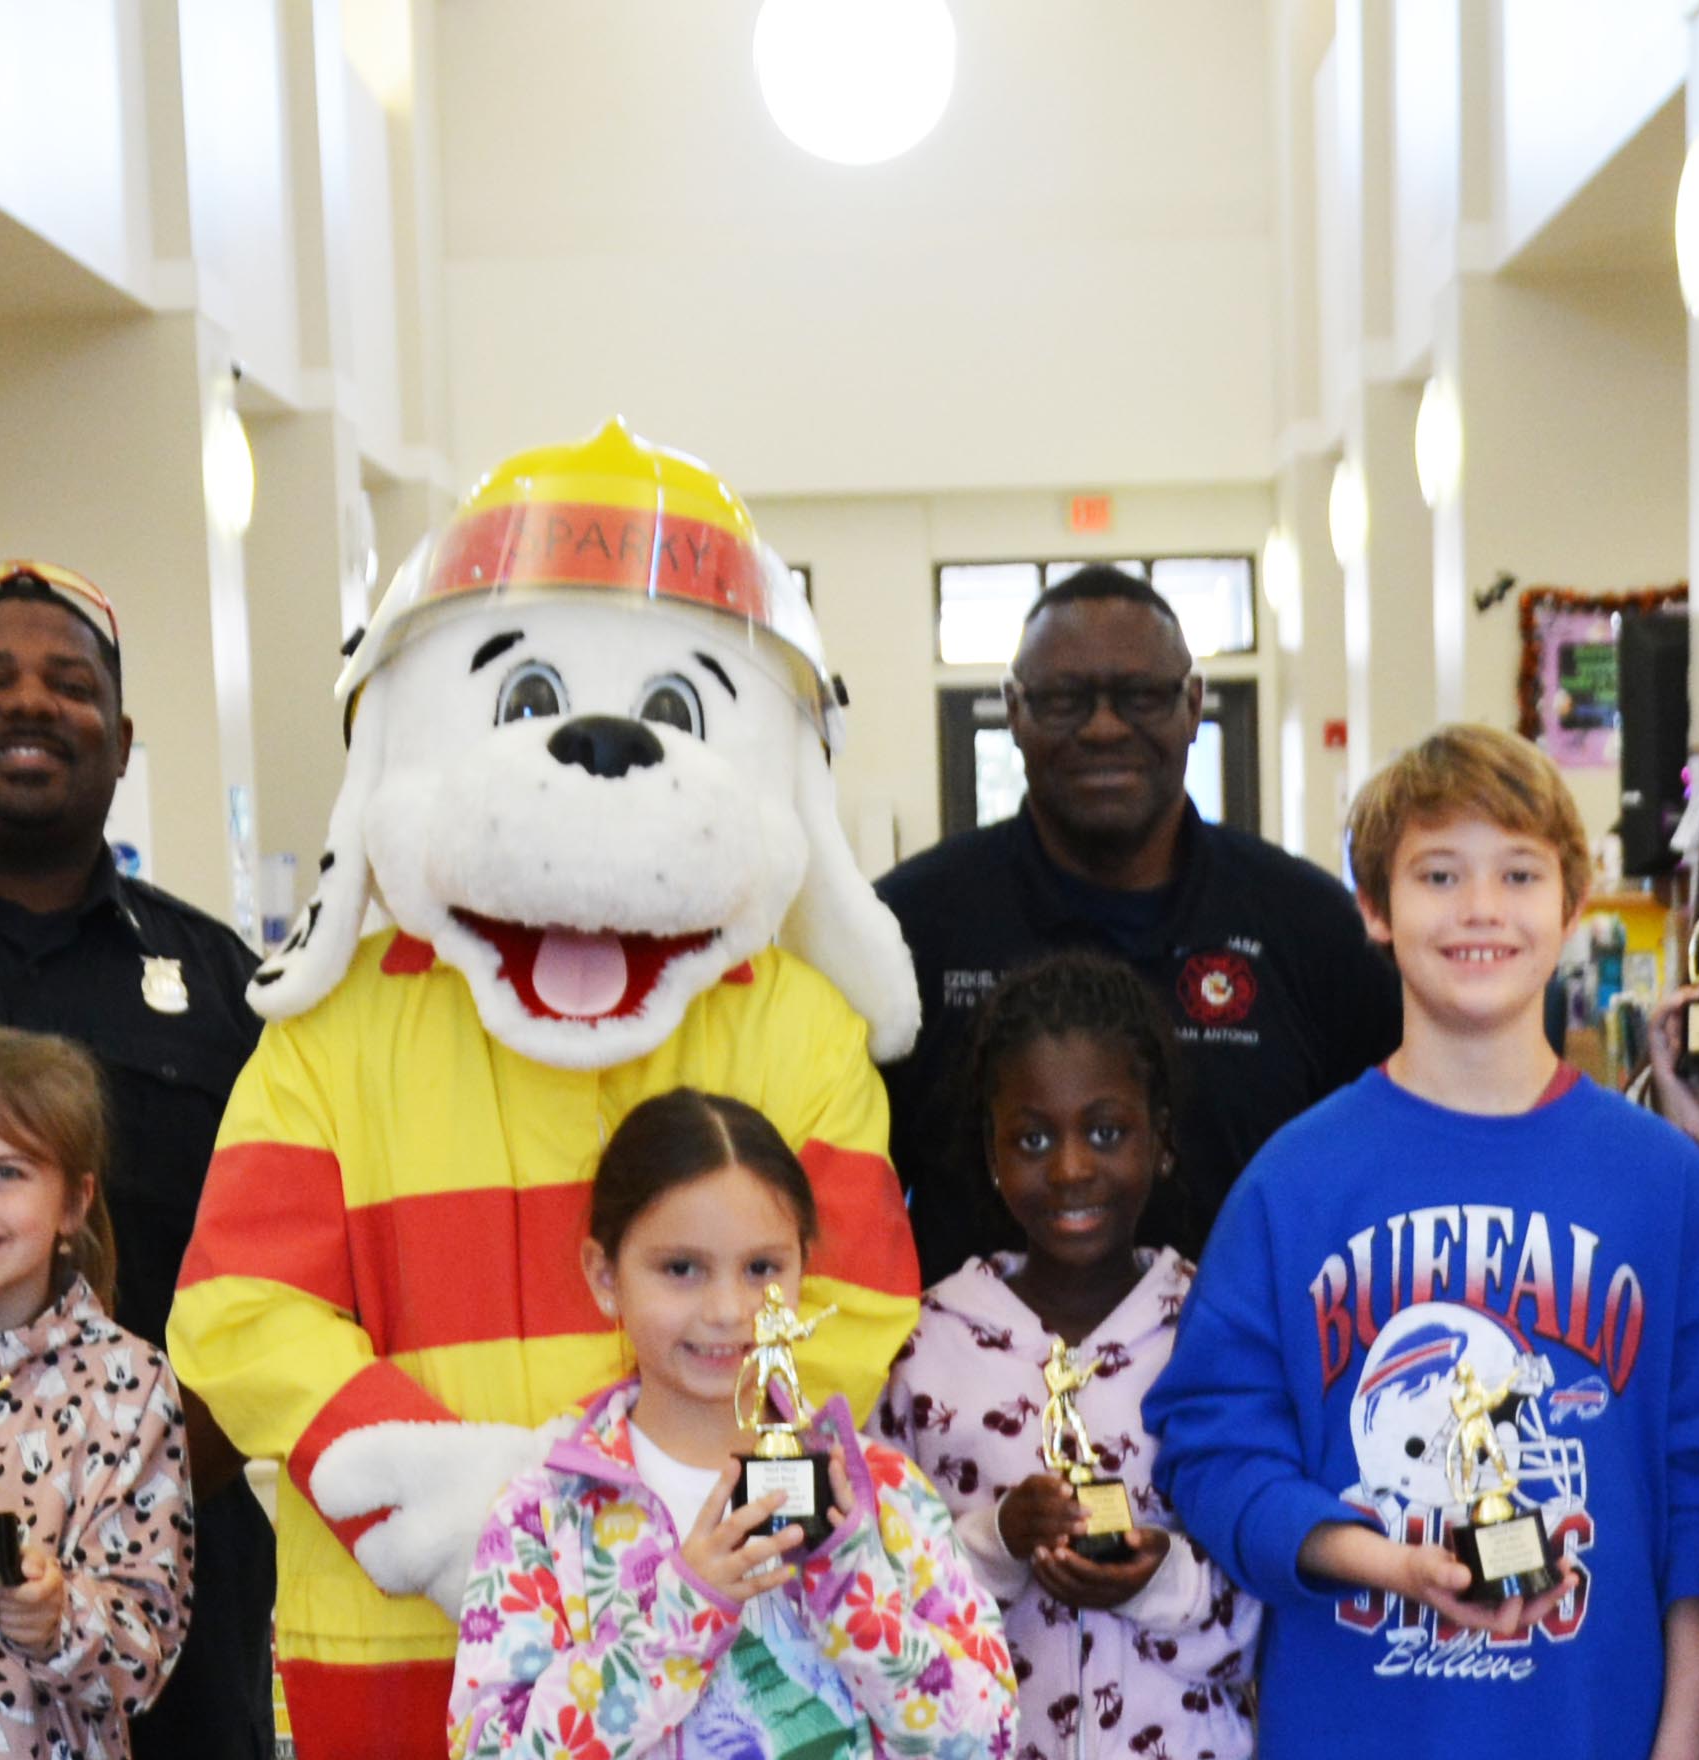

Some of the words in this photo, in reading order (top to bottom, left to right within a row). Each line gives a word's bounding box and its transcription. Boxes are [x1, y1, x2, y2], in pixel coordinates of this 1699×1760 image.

[508, 510, 715, 577] SPARKY
[1203, 1027, 1259, 1043] ANTONIO
[1308, 1205, 1645, 1396] BUFFALO
[1374, 1627, 1537, 1681] Billieve
